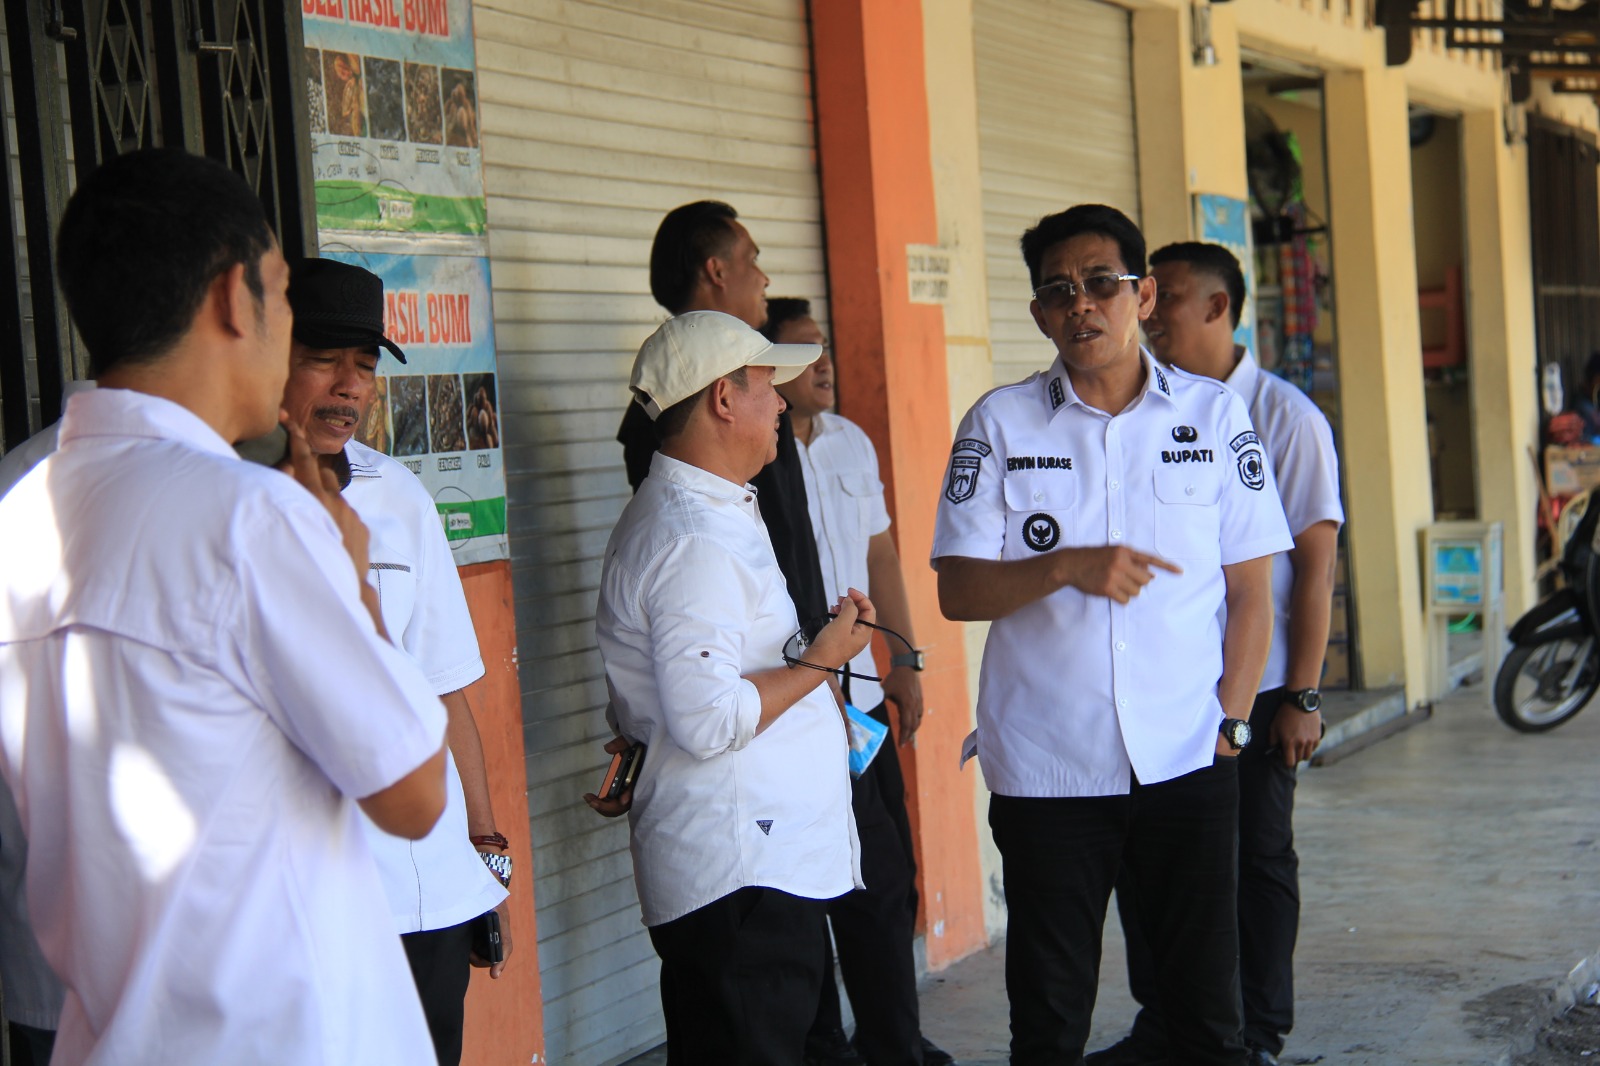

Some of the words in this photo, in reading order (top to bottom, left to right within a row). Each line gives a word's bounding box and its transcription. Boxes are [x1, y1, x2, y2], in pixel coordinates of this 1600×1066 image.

[383, 292, 425, 344] ASIL
[426, 292, 471, 344] BUMI
[1006, 456, 1035, 471] ERWIN
[1037, 456, 1072, 470] BURASE
[1161, 449, 1213, 463] BUPATI
